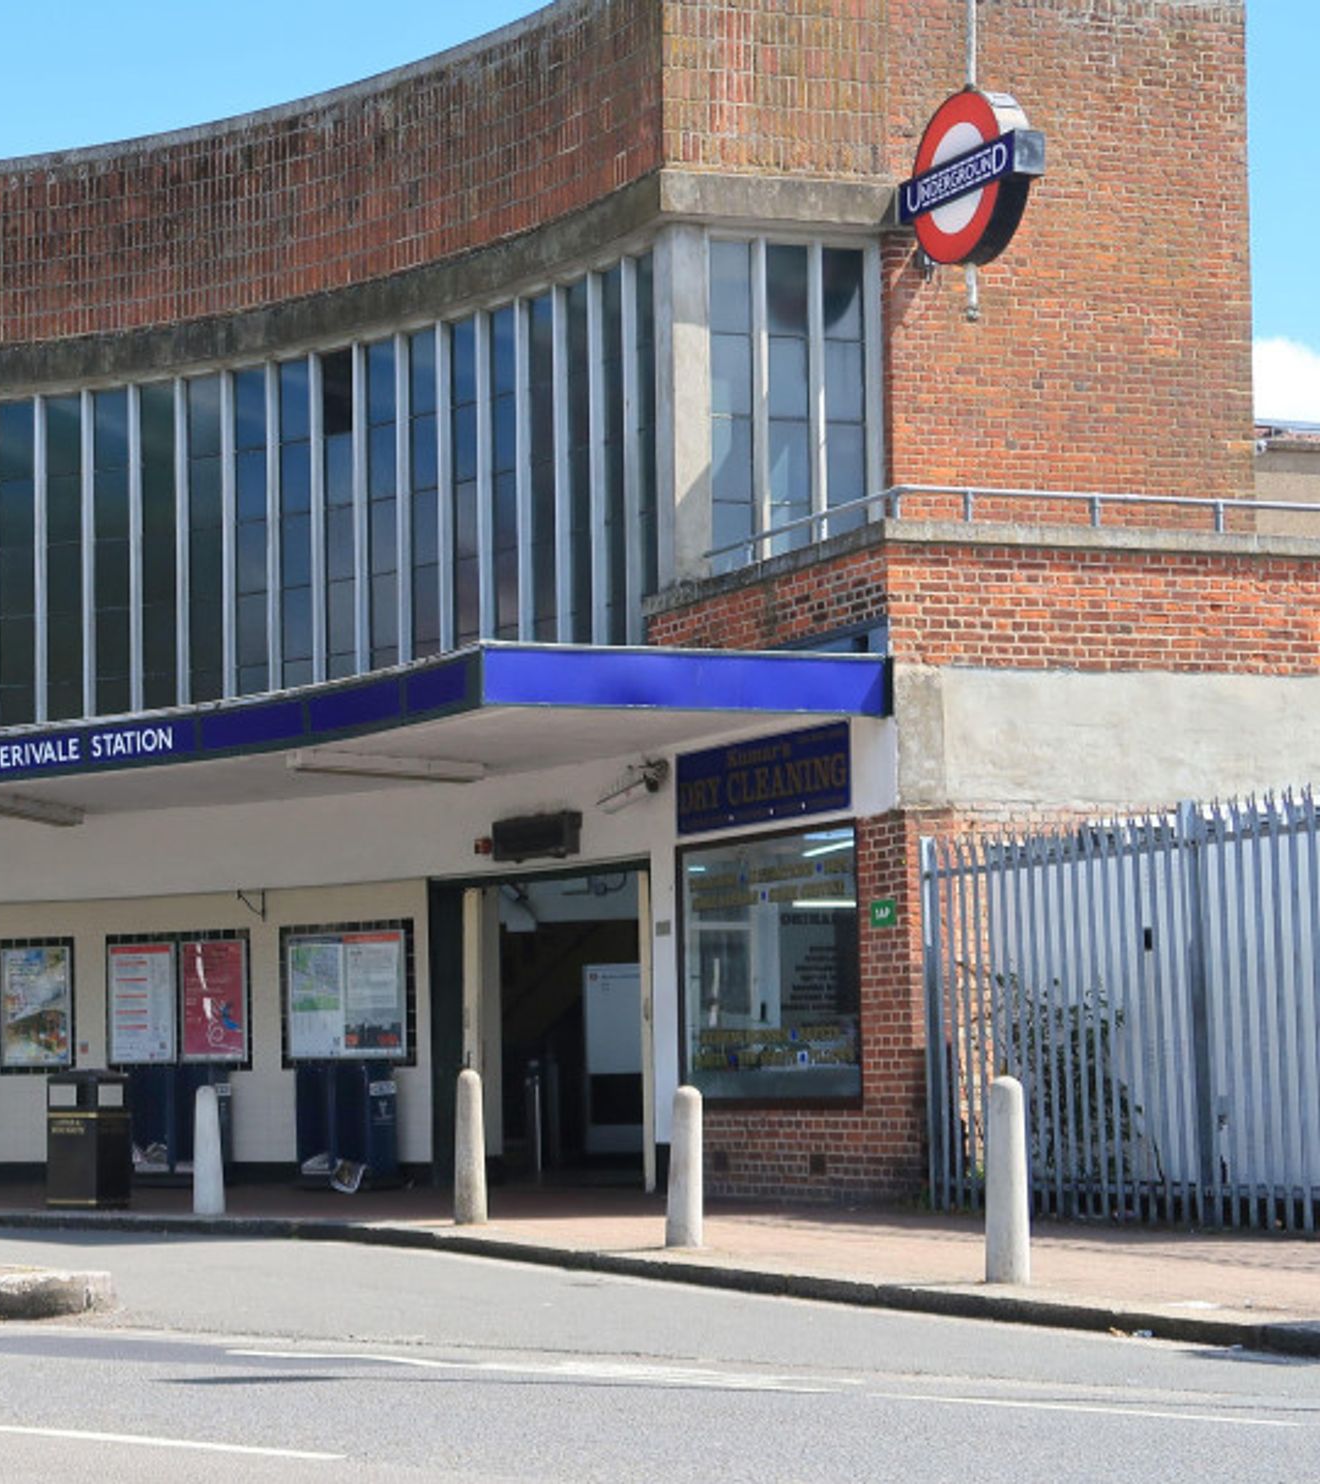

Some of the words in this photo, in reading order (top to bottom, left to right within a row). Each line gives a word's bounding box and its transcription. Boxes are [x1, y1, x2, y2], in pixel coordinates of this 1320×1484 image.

[906, 142, 1008, 212] UNDERGROUND
[91, 726, 173, 757] STATION
[681, 776, 720, 815] DRY
[727, 752, 847, 807] CLEANING
